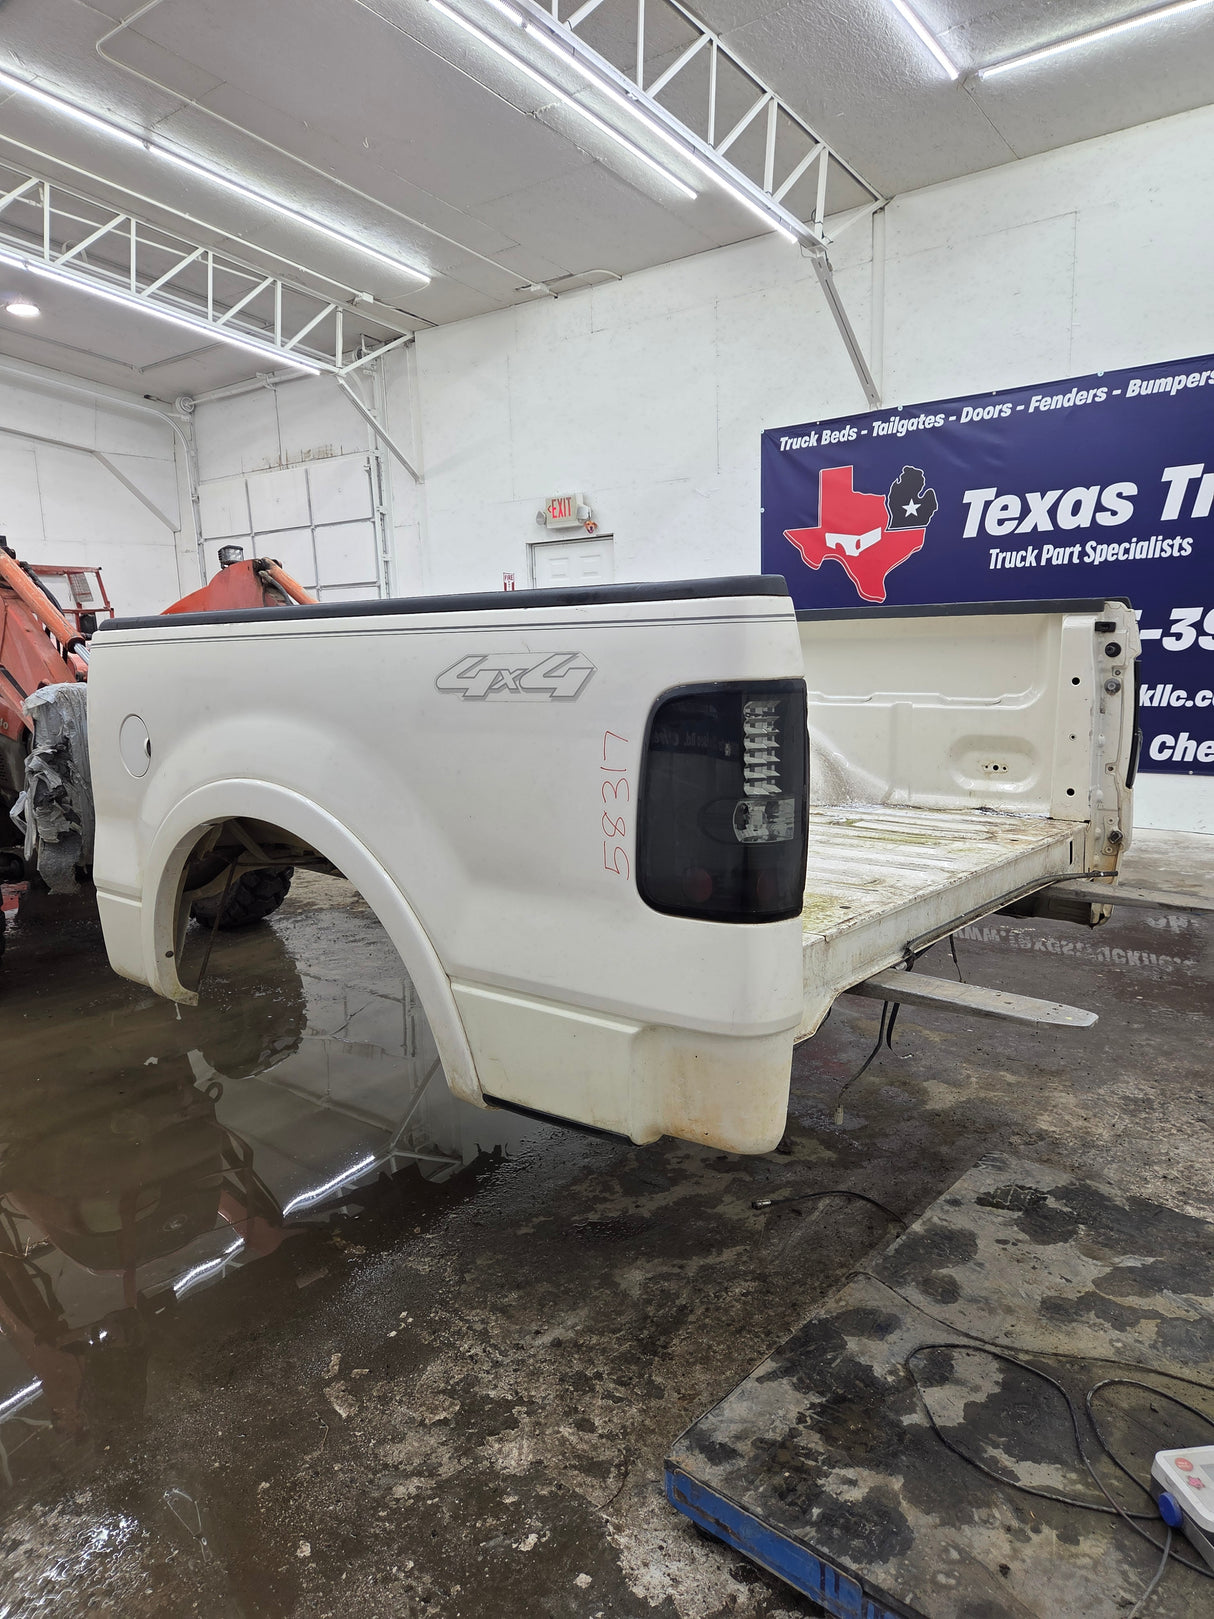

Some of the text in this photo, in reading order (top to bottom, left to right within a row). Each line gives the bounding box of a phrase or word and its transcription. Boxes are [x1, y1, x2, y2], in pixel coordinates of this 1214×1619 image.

[779, 431, 818, 451] Truck
[821, 425, 858, 445] Beds
[872, 413, 945, 437] Tailgates
[960, 402, 1012, 424] Doors
[1028, 386, 1108, 413] Fenders
[551, 497, 572, 519] EXIT
[962, 481, 1139, 539] Texas
[989, 535, 1194, 570] Truck Part Specialists
[435, 651, 598, 701] 4x4
[1139, 684, 1214, 707] kllc.c
[600, 730, 630, 881] 58317
